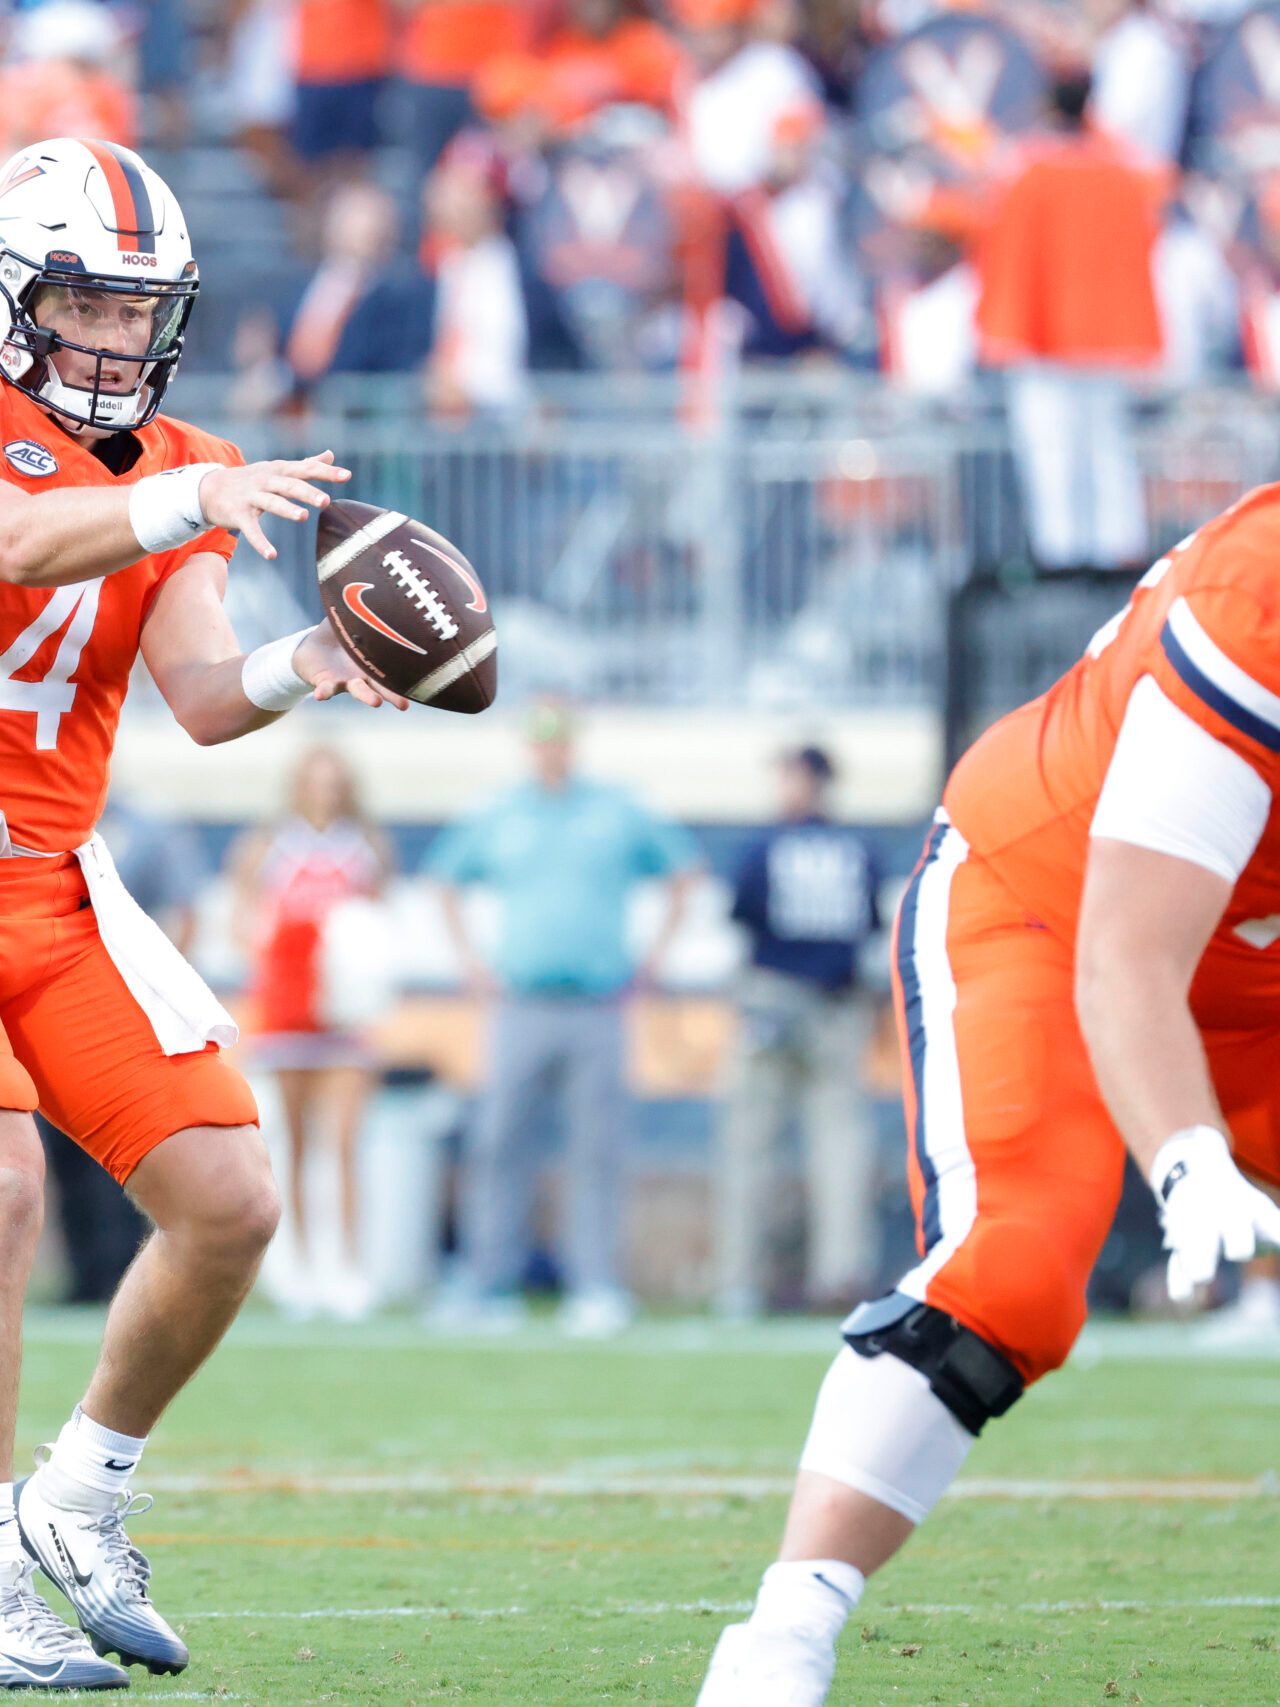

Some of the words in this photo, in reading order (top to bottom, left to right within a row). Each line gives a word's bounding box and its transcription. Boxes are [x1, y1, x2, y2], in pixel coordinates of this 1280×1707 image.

[50, 252, 79, 264] HOOS
[122, 254, 158, 267] HOOS
[87, 397, 123, 411] Rddell
[10, 447, 53, 469] ACC
[47, 1522, 66, 1563] AIR
